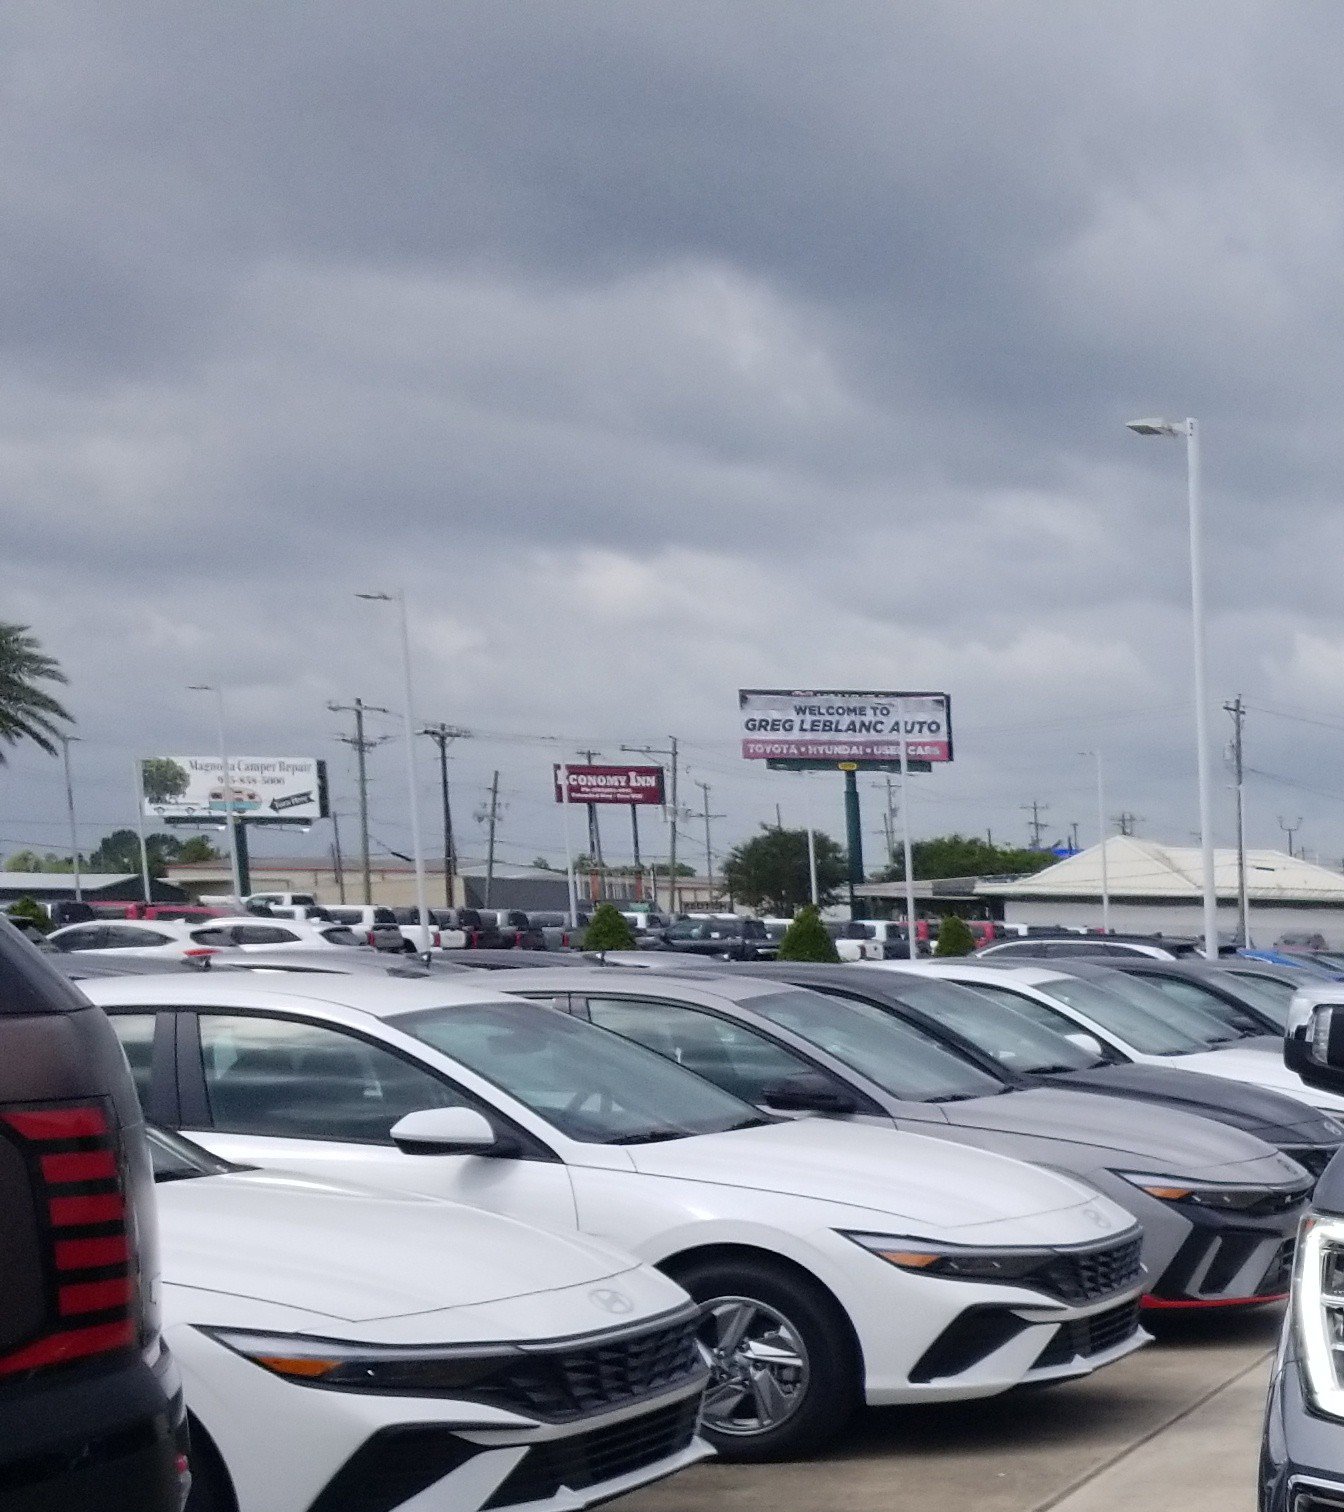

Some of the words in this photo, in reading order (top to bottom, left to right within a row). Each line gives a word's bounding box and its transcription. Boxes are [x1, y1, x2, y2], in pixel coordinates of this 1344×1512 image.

[794, 705, 866, 717] WELCOME
[870, 706, 890, 717] TO
[744, 718, 795, 732] GREG
[798, 719, 885, 734] LEBLANC
[889, 720, 941, 734] AUTO
[748, 744, 798, 754] TOYOTA
[807, 745, 863, 755] HYUNDAI
[189, 759, 235, 772] Magnoa
[237, 760, 276, 774] Camper
[279, 761, 311, 775] Repair
[628, 771, 656, 787] INN
